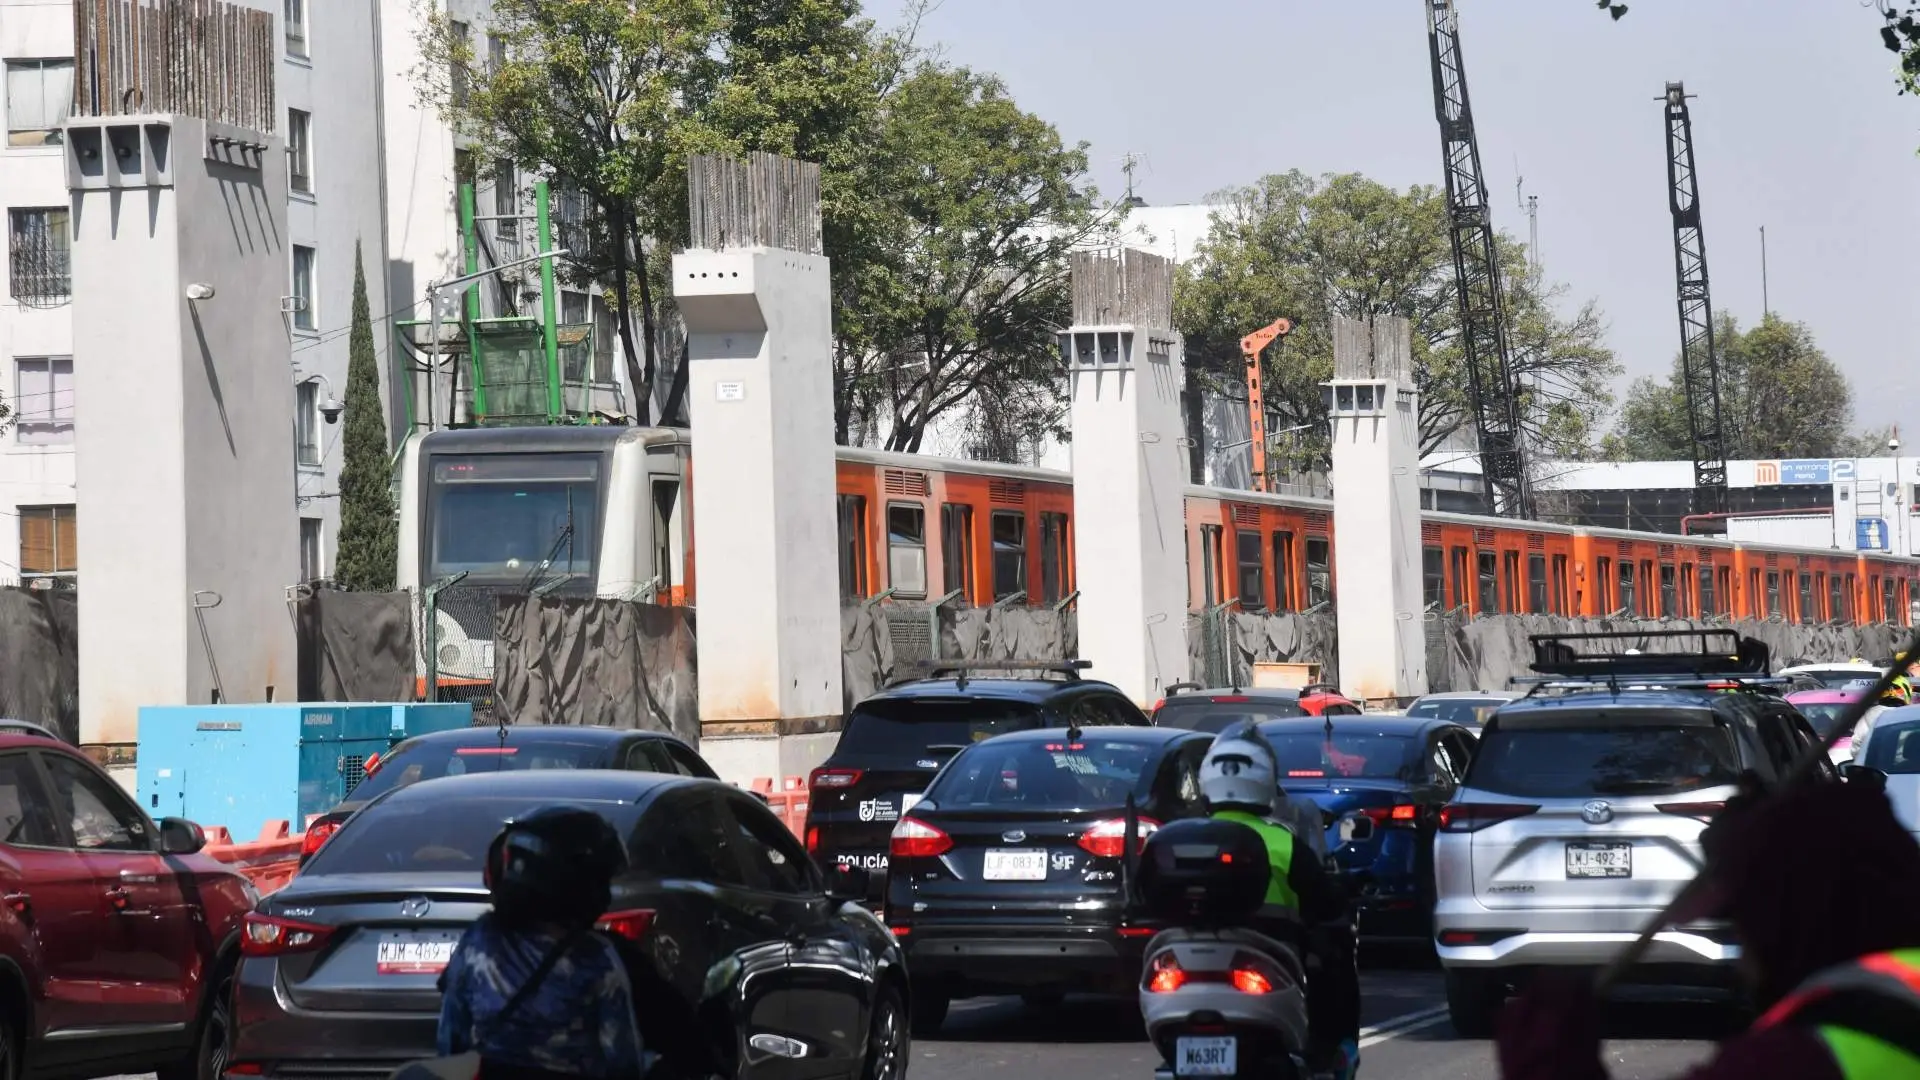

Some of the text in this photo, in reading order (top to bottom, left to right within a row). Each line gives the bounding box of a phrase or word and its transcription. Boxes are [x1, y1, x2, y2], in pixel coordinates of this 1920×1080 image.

[1833, 461, 1855, 481] 2
[304, 713, 332, 725] AIRMAN
[837, 853, 889, 869] POLICÍA
